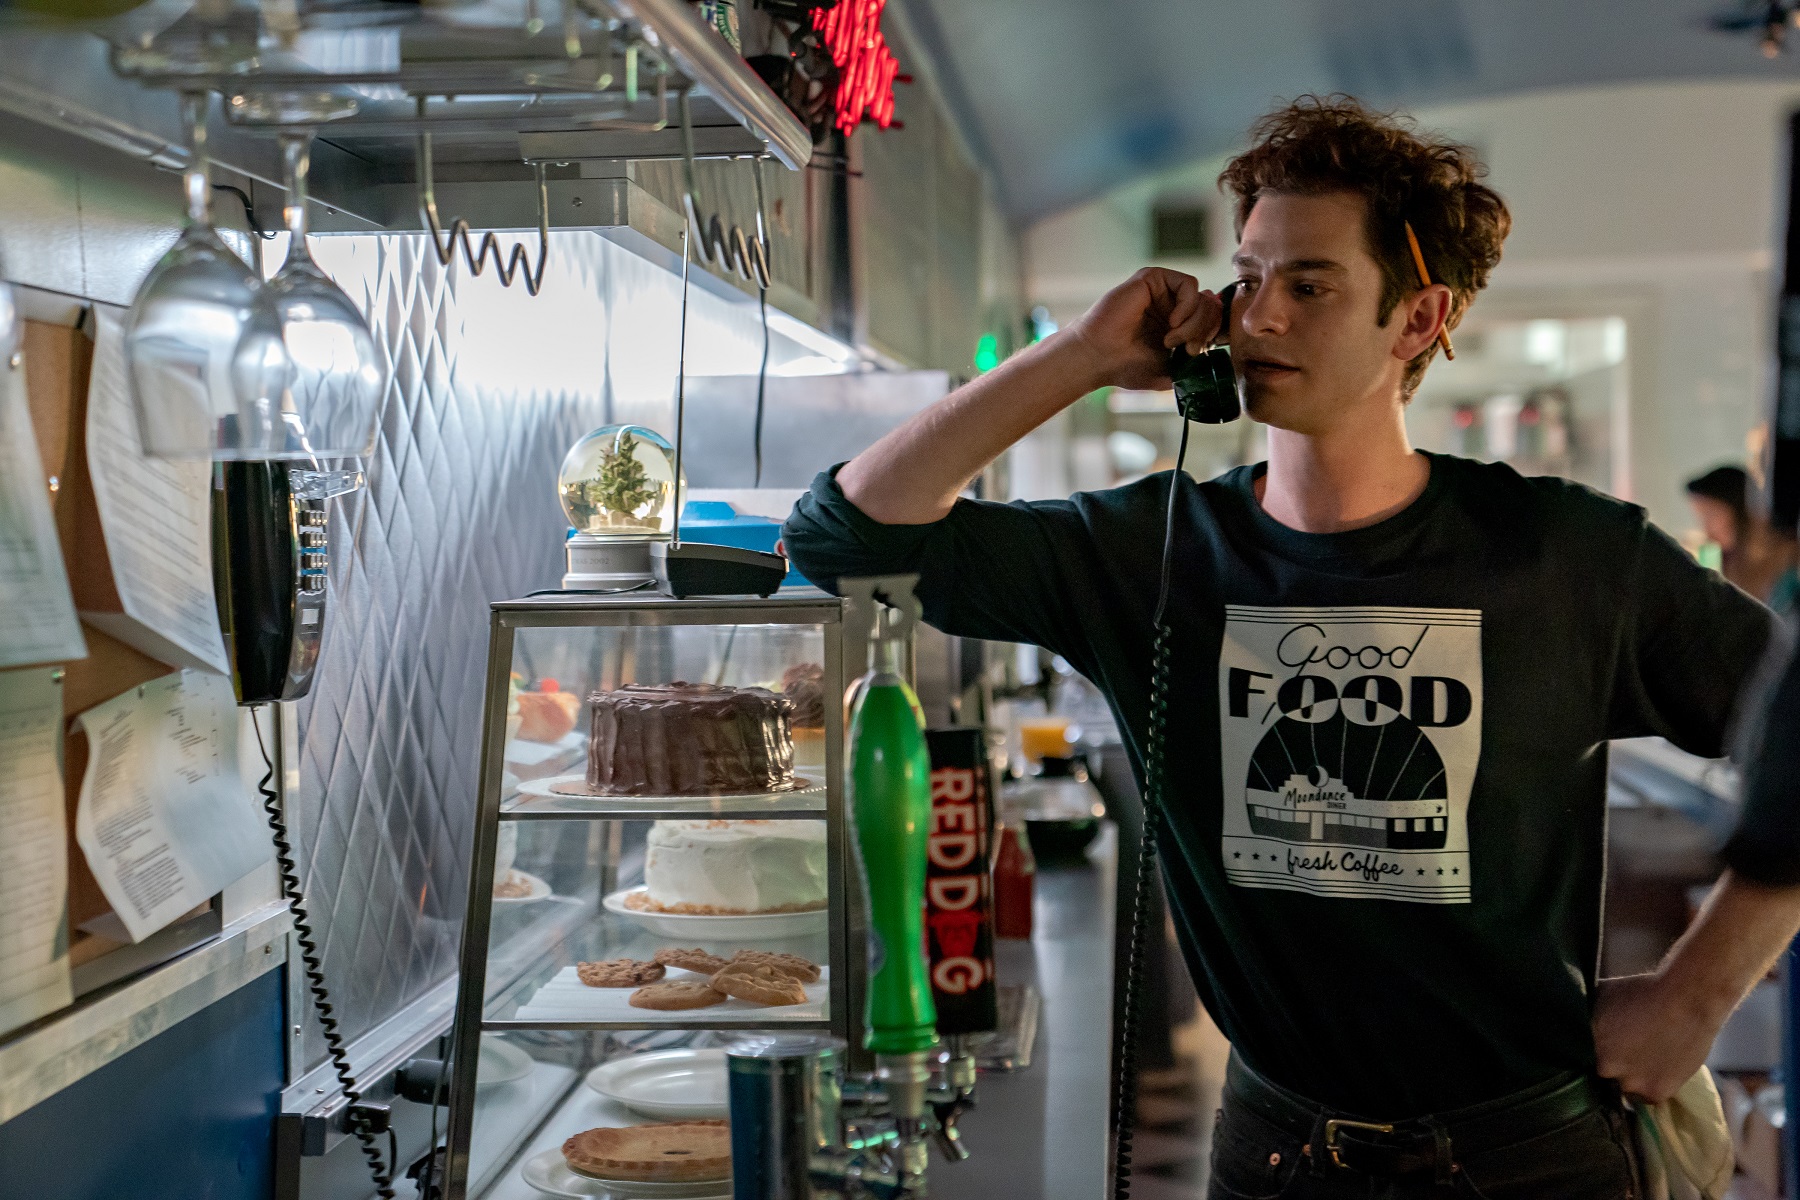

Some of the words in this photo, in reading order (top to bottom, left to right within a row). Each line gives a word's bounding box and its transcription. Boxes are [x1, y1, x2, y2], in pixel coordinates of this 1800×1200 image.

[1276, 623, 1429, 680] Good
[1228, 667, 1472, 728] FOOD
[929, 766, 978, 870] RED
[1284, 788, 1346, 809] Moondance
[1287, 848, 1338, 875] fresh
[1341, 851, 1404, 882] Coffee
[927, 875, 985, 995] DG
